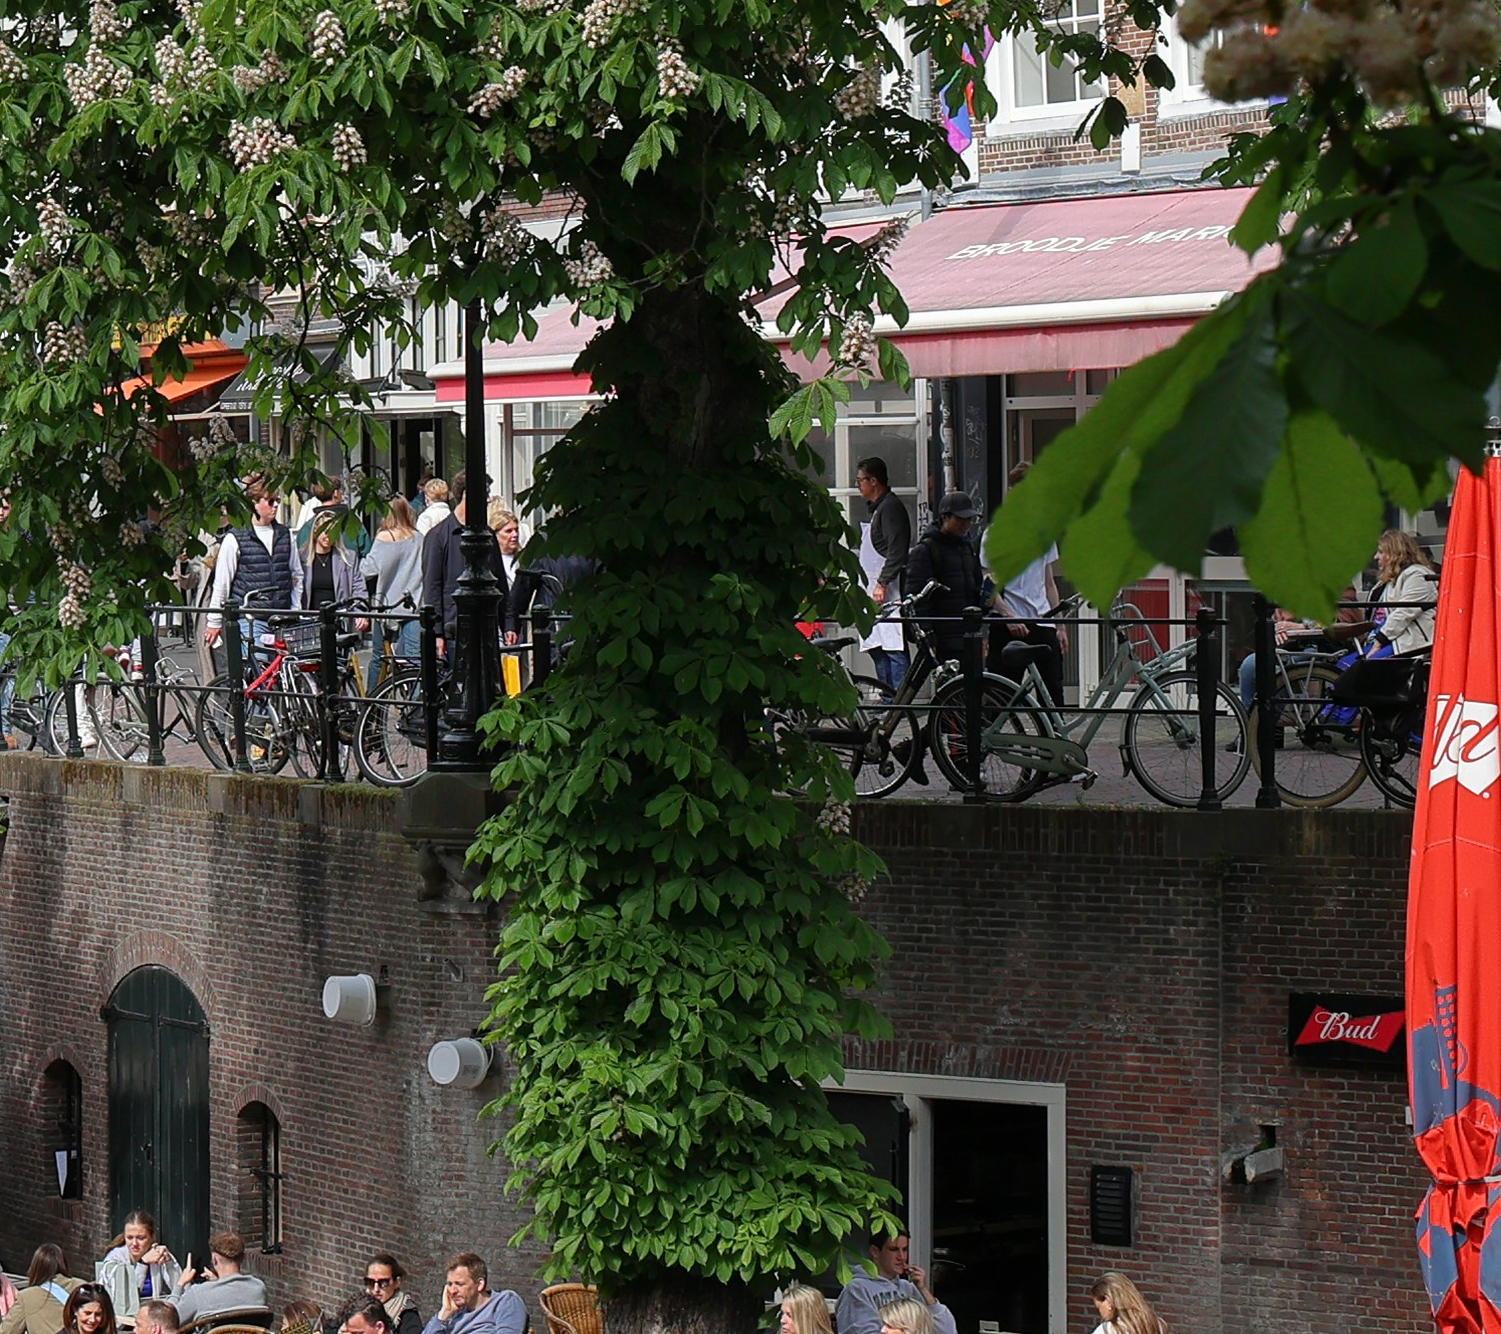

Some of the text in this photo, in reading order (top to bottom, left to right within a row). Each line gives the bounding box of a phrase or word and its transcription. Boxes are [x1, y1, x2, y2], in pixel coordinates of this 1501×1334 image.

[945, 225, 1236, 260] BROODJE MARI
[1315, 1011, 1379, 1040] Bud
